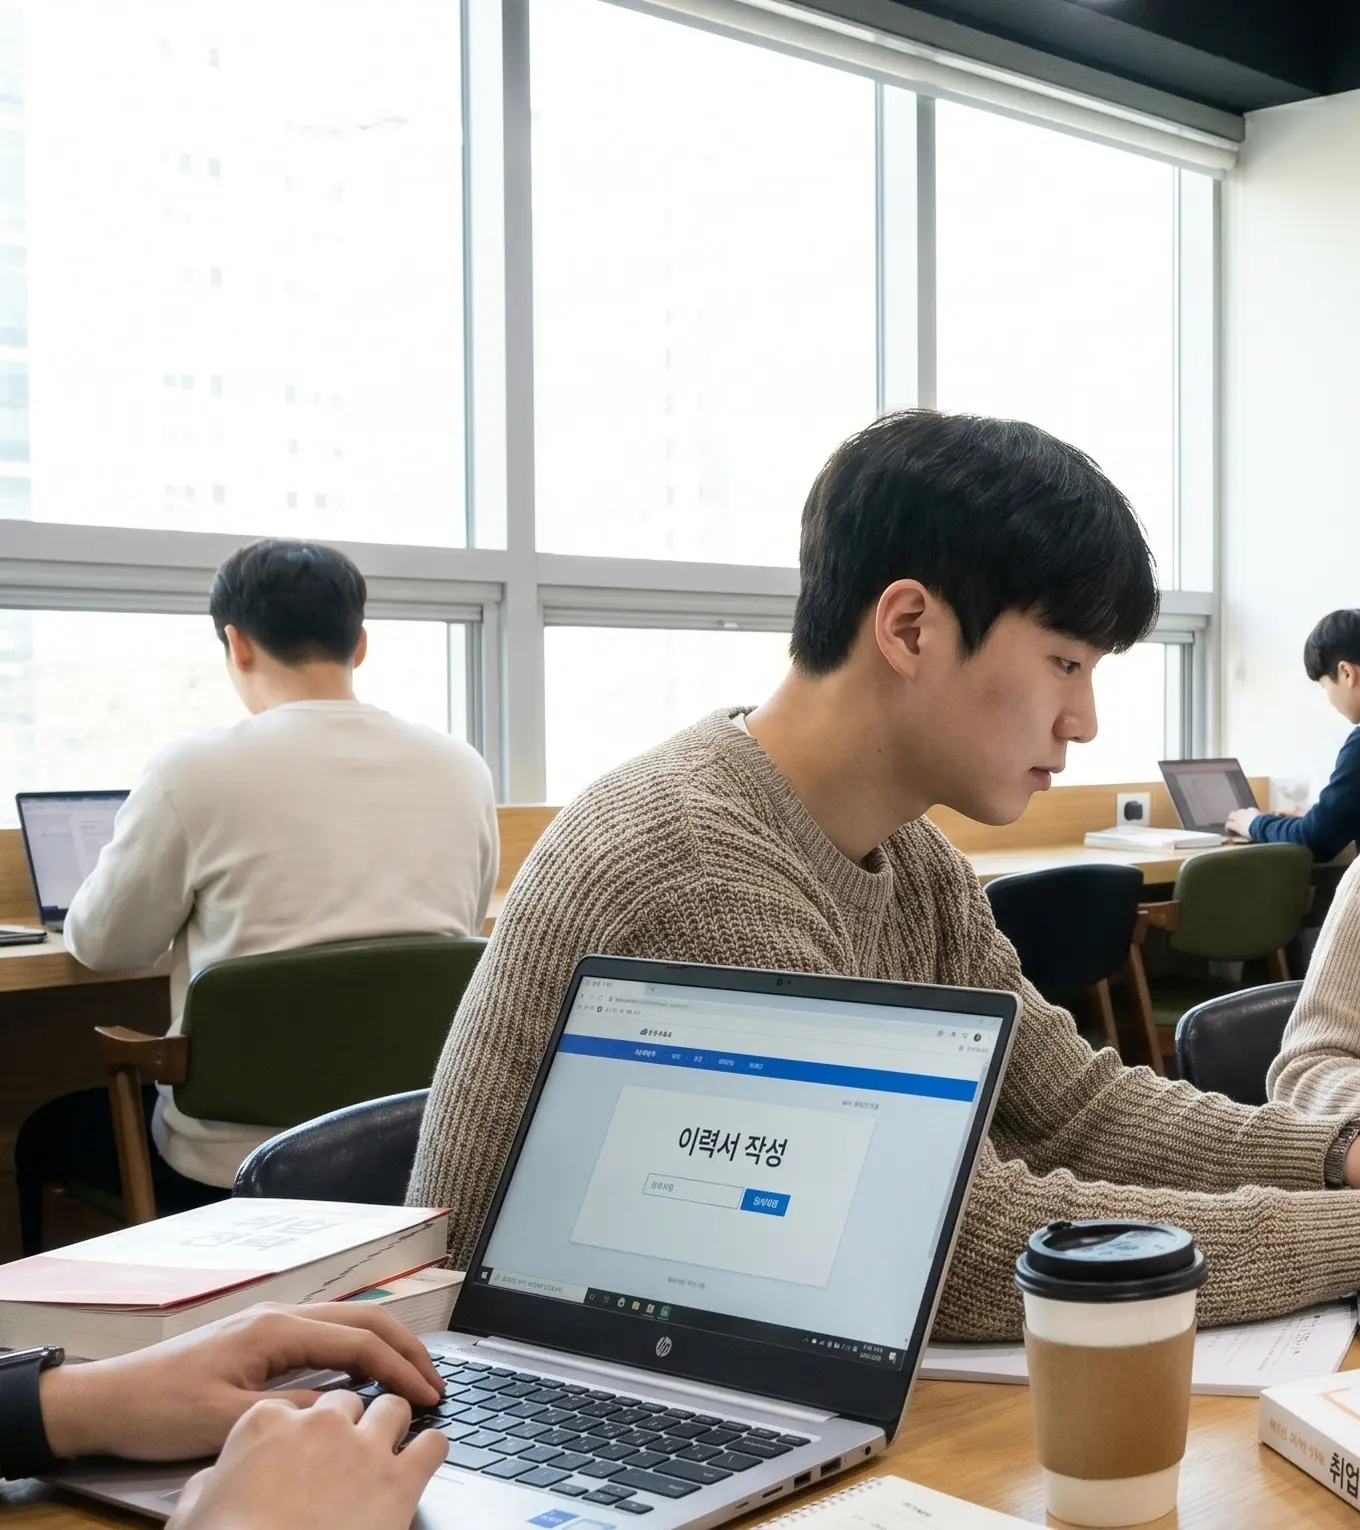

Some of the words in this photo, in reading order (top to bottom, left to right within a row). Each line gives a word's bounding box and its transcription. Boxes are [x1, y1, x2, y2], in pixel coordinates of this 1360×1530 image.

[677, 1126, 740, 1162] 이력서
[744, 1133, 788, 1168] 작성
[1329, 1451, 1360, 1500] 취업
